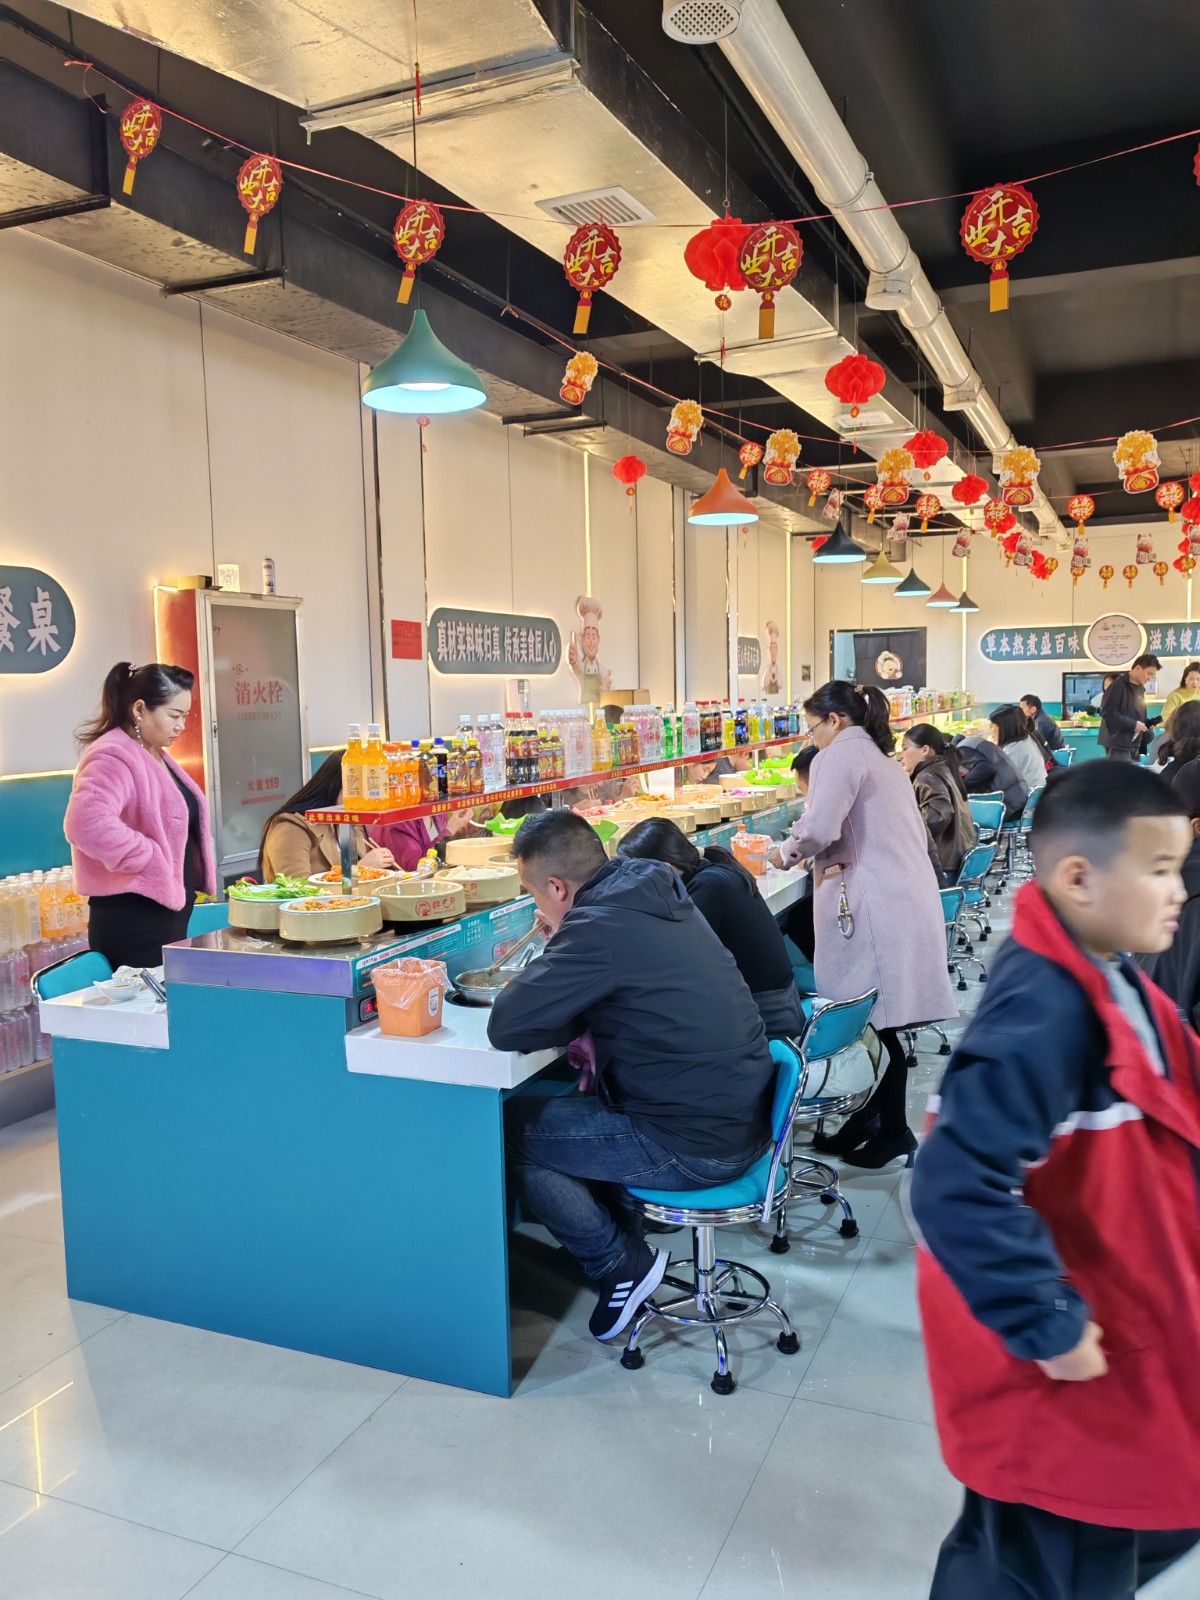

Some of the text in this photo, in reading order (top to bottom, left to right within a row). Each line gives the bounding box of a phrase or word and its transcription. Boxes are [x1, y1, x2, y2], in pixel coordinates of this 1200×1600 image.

[965, 190, 1033, 258] 开业大吉
[566, 230, 617, 286] 开业大吉
[740, 225, 799, 287] 开业大吉
[985, 631, 1081, 657] 草本熬煮盛百味
[235, 681, 284, 705] 消火栓
